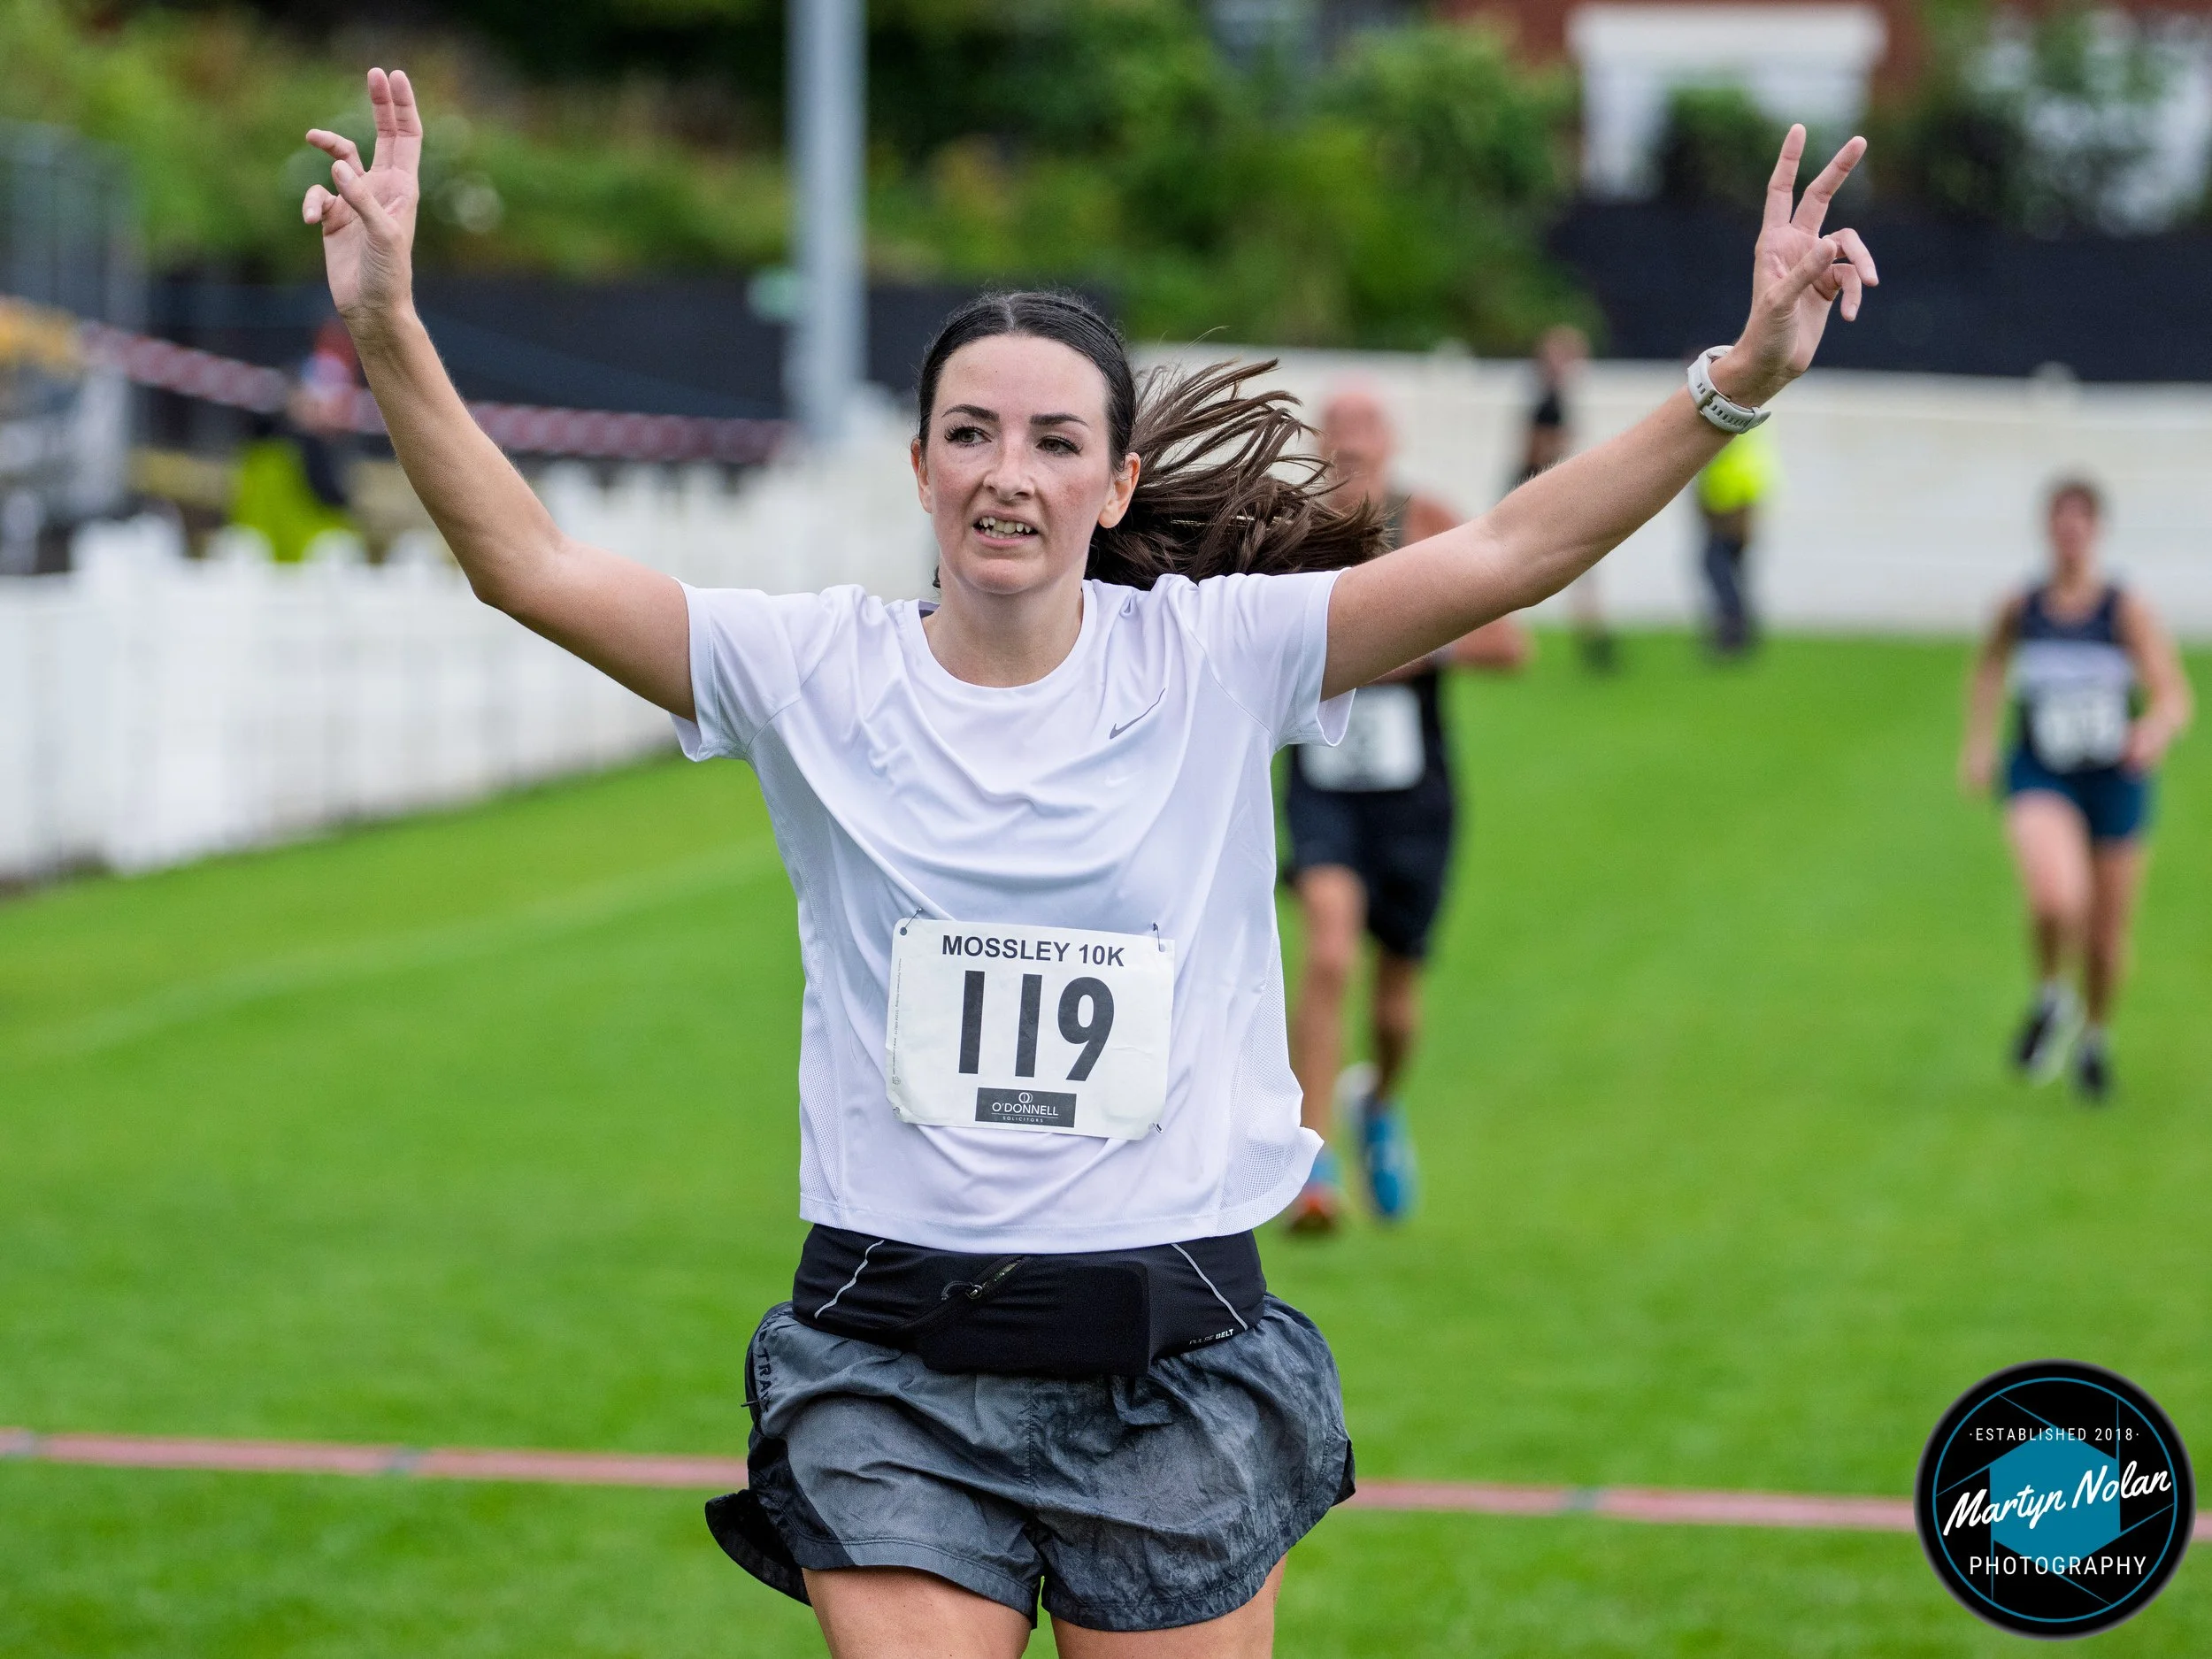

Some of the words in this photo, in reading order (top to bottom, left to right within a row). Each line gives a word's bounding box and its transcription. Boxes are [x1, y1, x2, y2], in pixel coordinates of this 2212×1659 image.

[941, 934, 1071, 962] MOSSLEY
[1078, 943, 1125, 967] 10K
[958, 970, 1115, 1082] 119
[992, 1102, 1058, 1116] O'DONNELL
